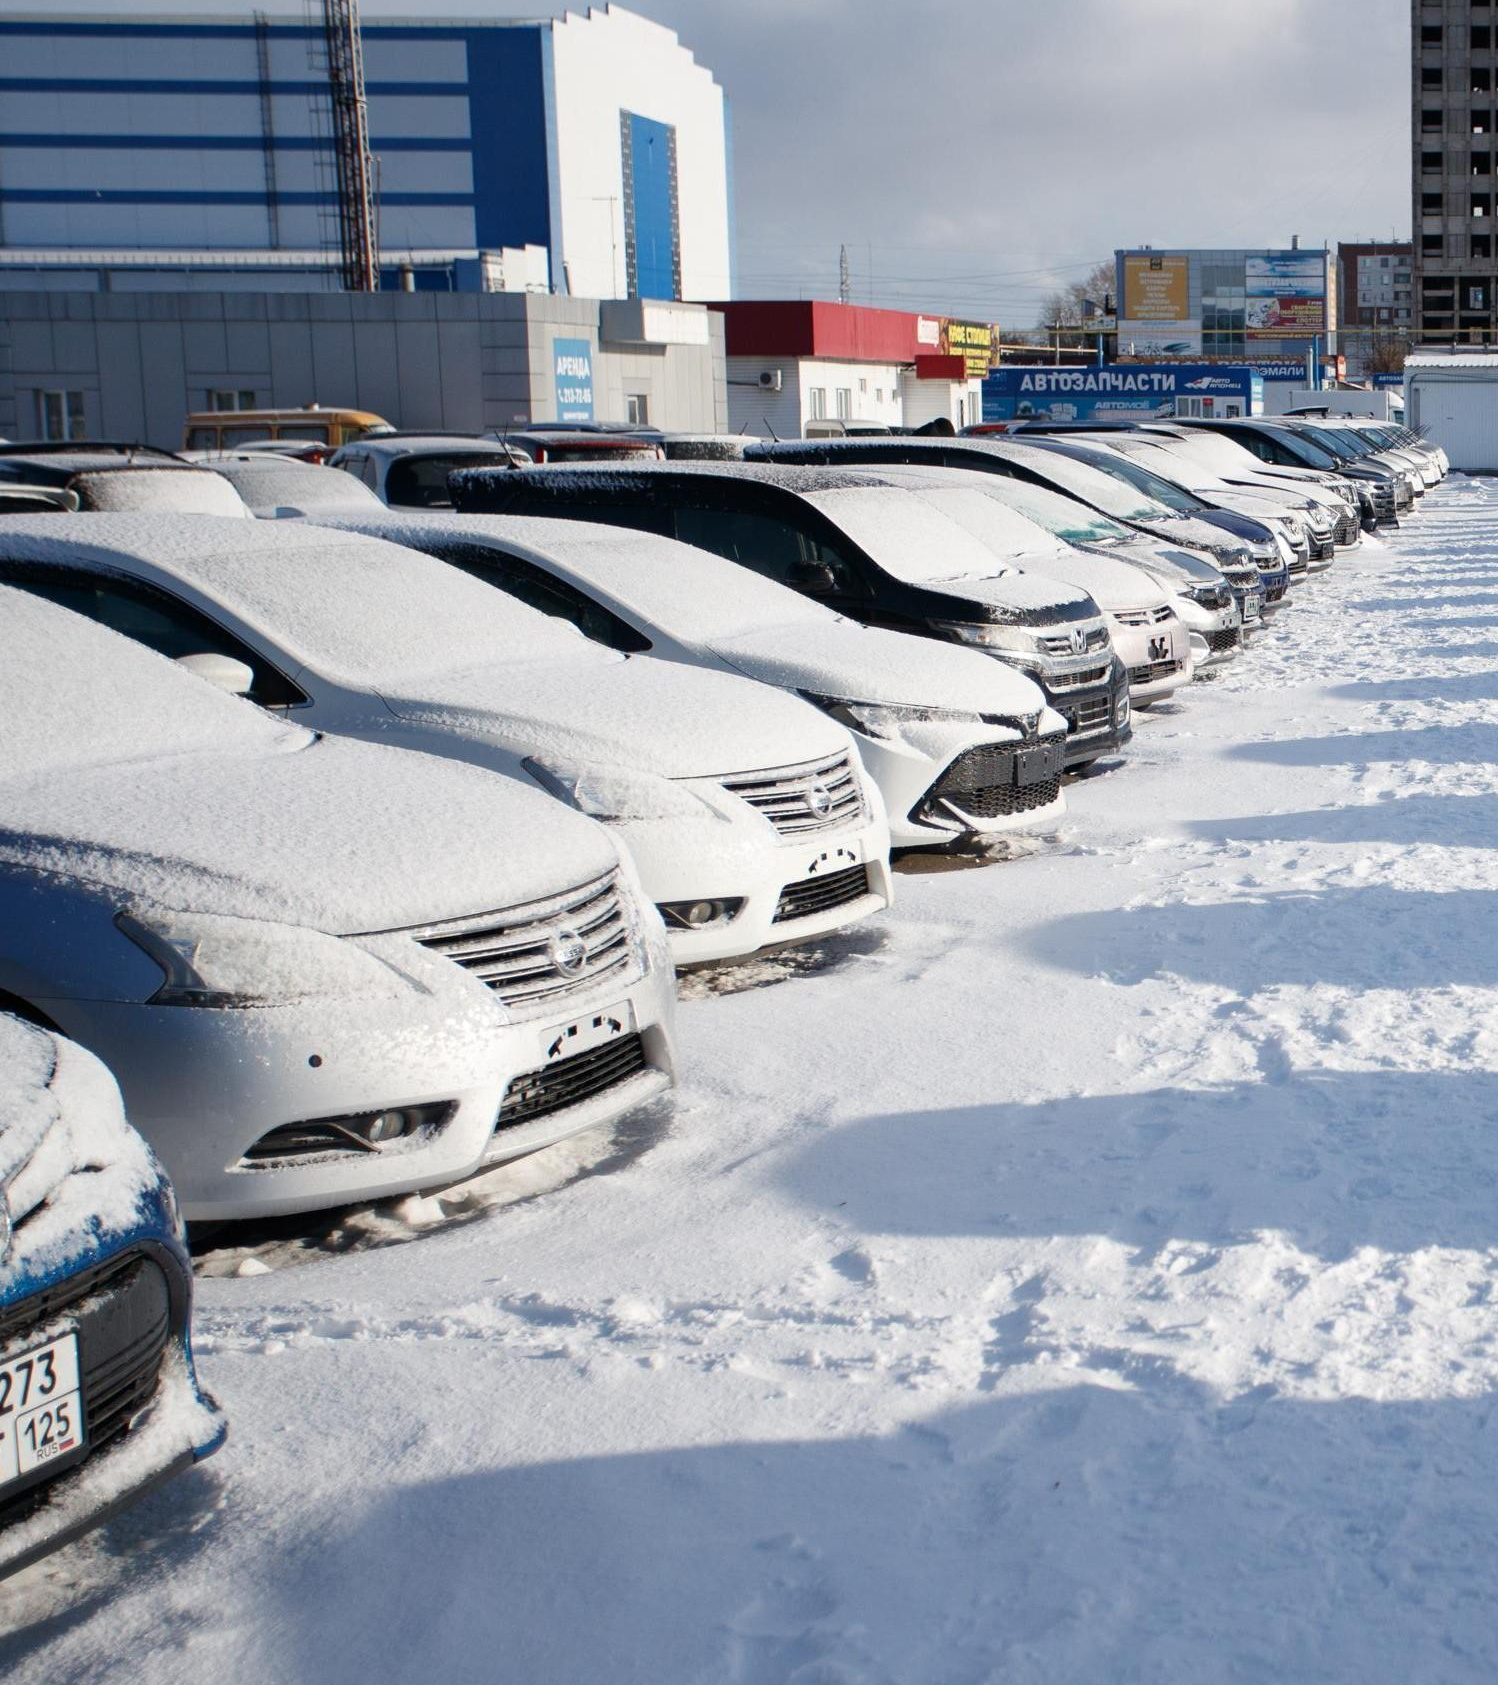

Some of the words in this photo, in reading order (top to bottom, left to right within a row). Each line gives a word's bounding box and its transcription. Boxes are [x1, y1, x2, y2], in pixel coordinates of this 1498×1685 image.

[557, 356, 590, 379] АРЕНДА
[1020, 372, 1176, 391] АВТОЗАПЧАСТИ
[24, 1402, 70, 1451] 125
[37, 1443, 58, 1461] RUS
